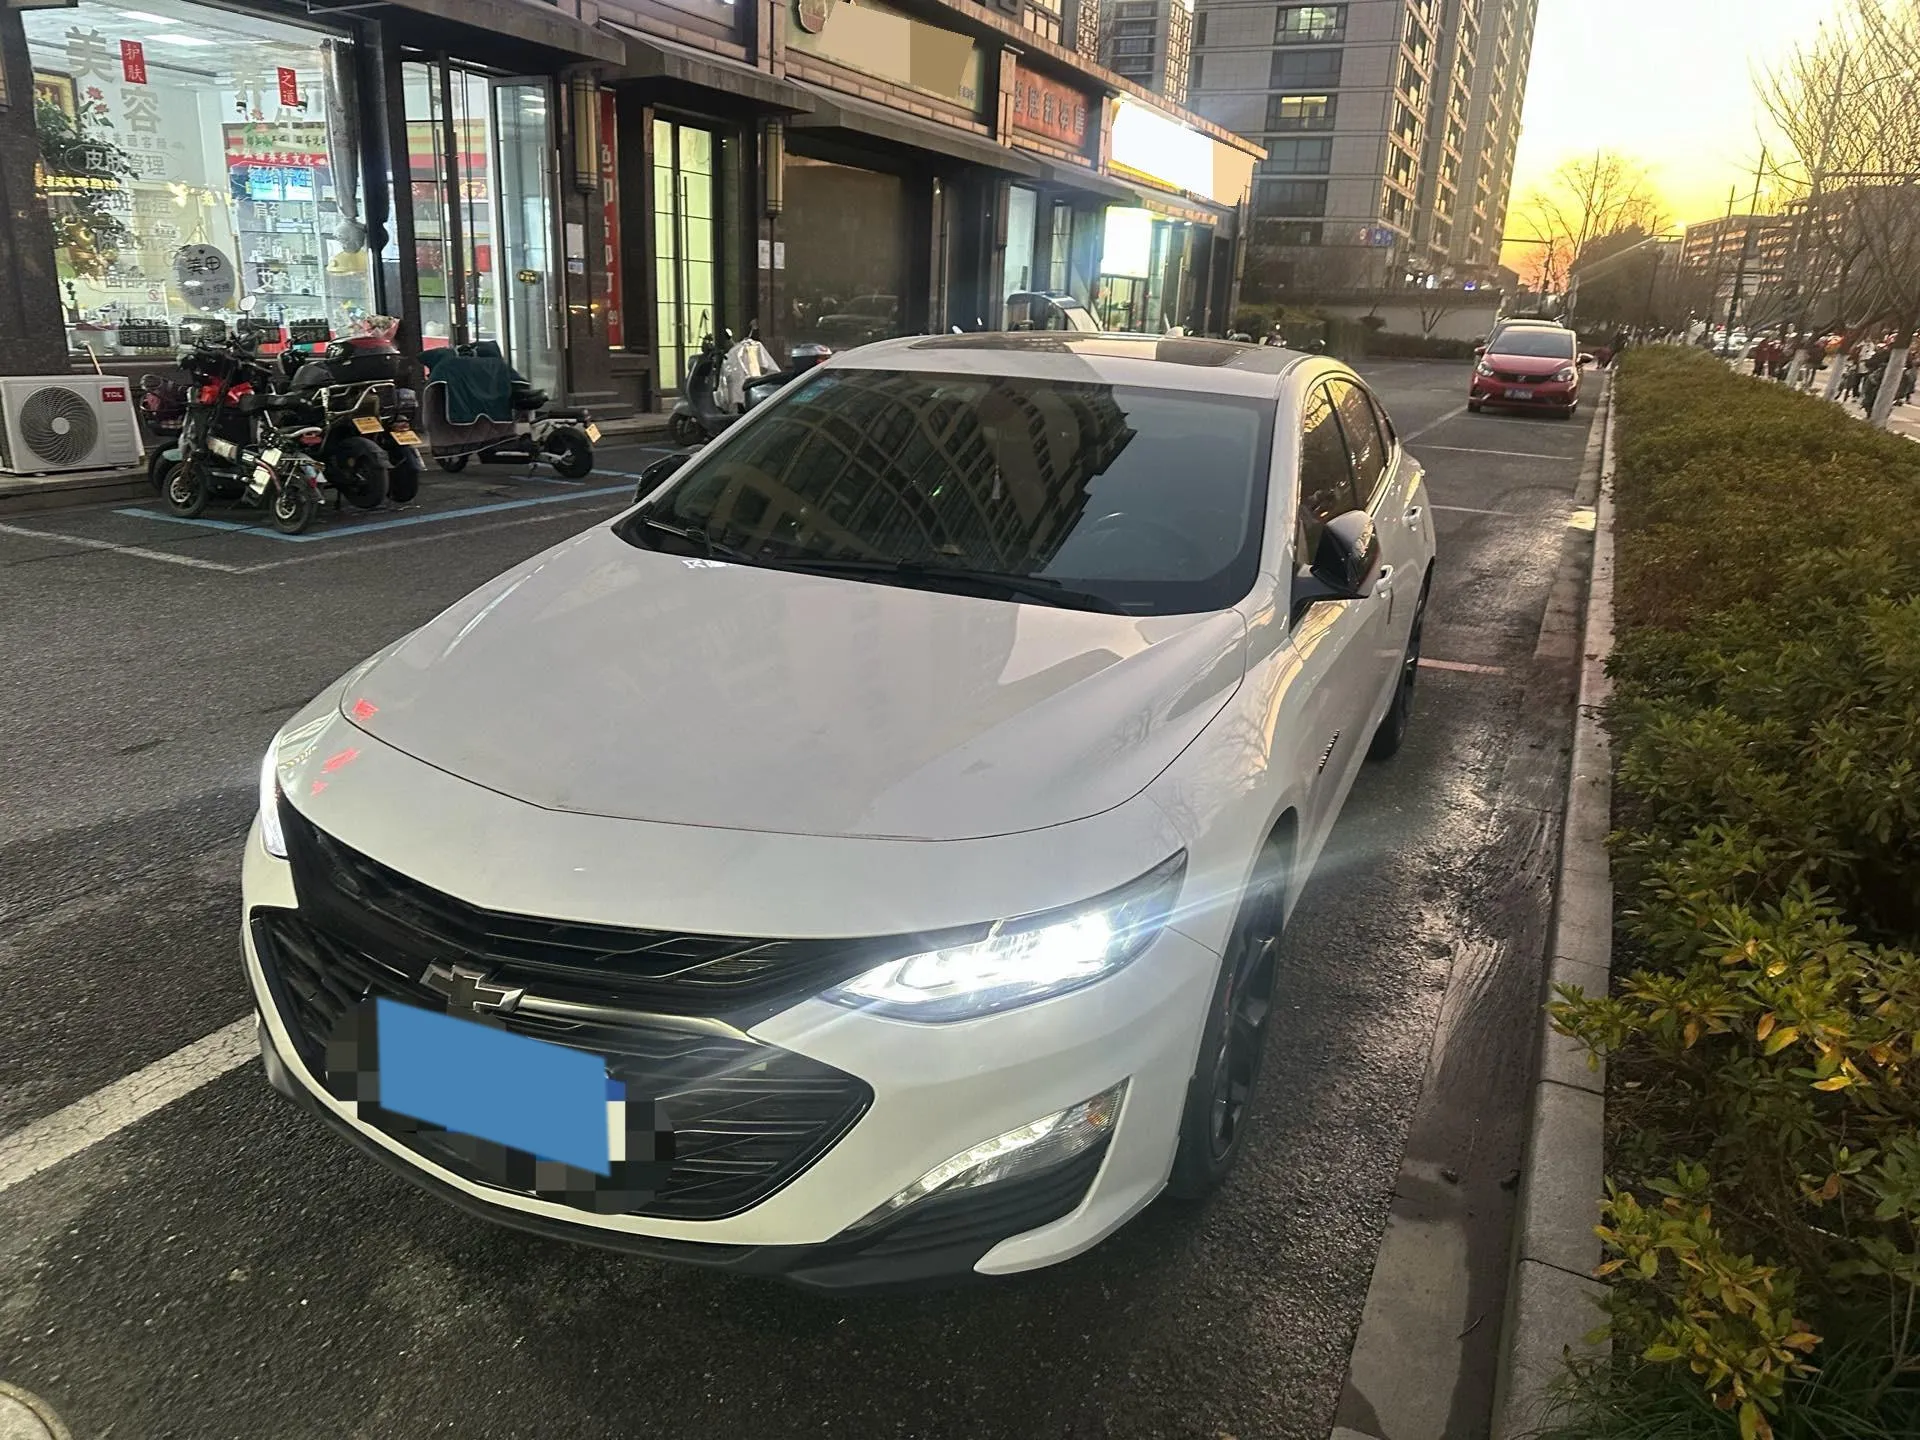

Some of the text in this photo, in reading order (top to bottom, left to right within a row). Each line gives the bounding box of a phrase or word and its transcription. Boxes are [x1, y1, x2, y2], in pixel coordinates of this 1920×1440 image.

[126, 43, 144, 82] 护肤
[281, 71, 297, 106] 之道
[85, 149, 166, 175] 皮肤管理
